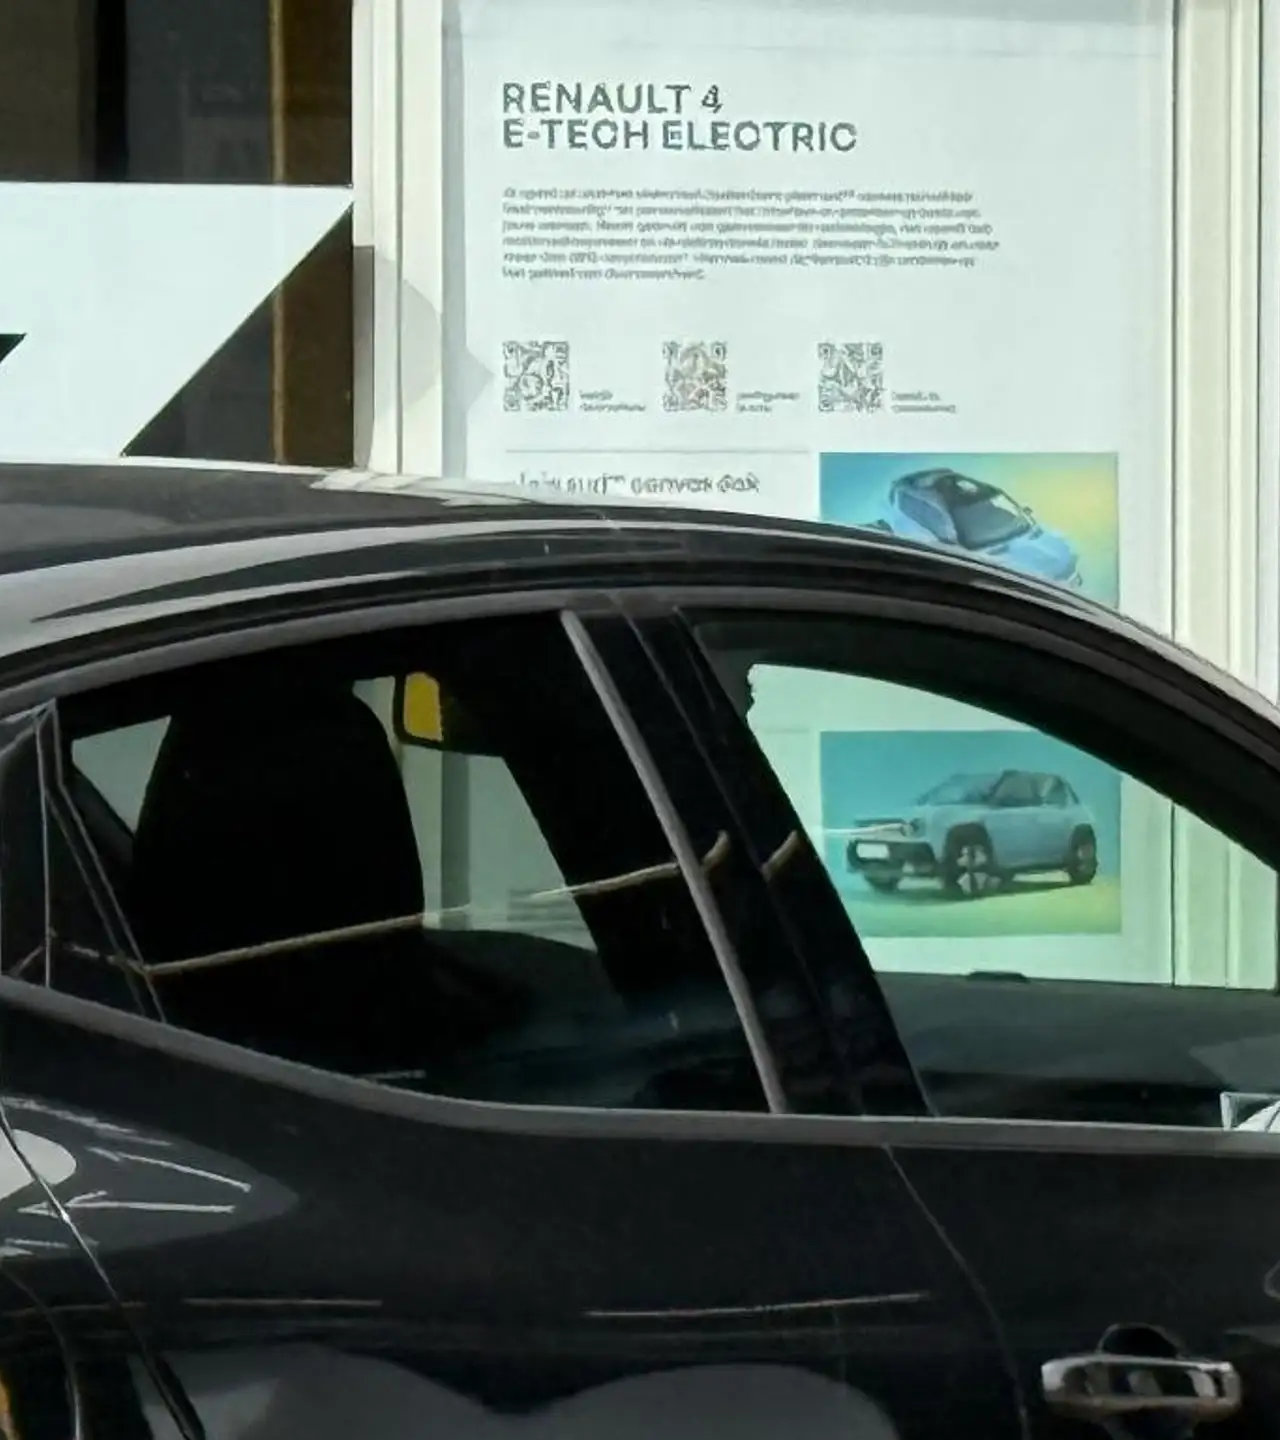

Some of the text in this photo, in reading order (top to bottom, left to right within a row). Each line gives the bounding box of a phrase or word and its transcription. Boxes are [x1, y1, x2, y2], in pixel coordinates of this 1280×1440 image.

[502, 82, 724, 114] RENAULT 4
[502, 119, 858, 152] E-TECH ELECTRIC
